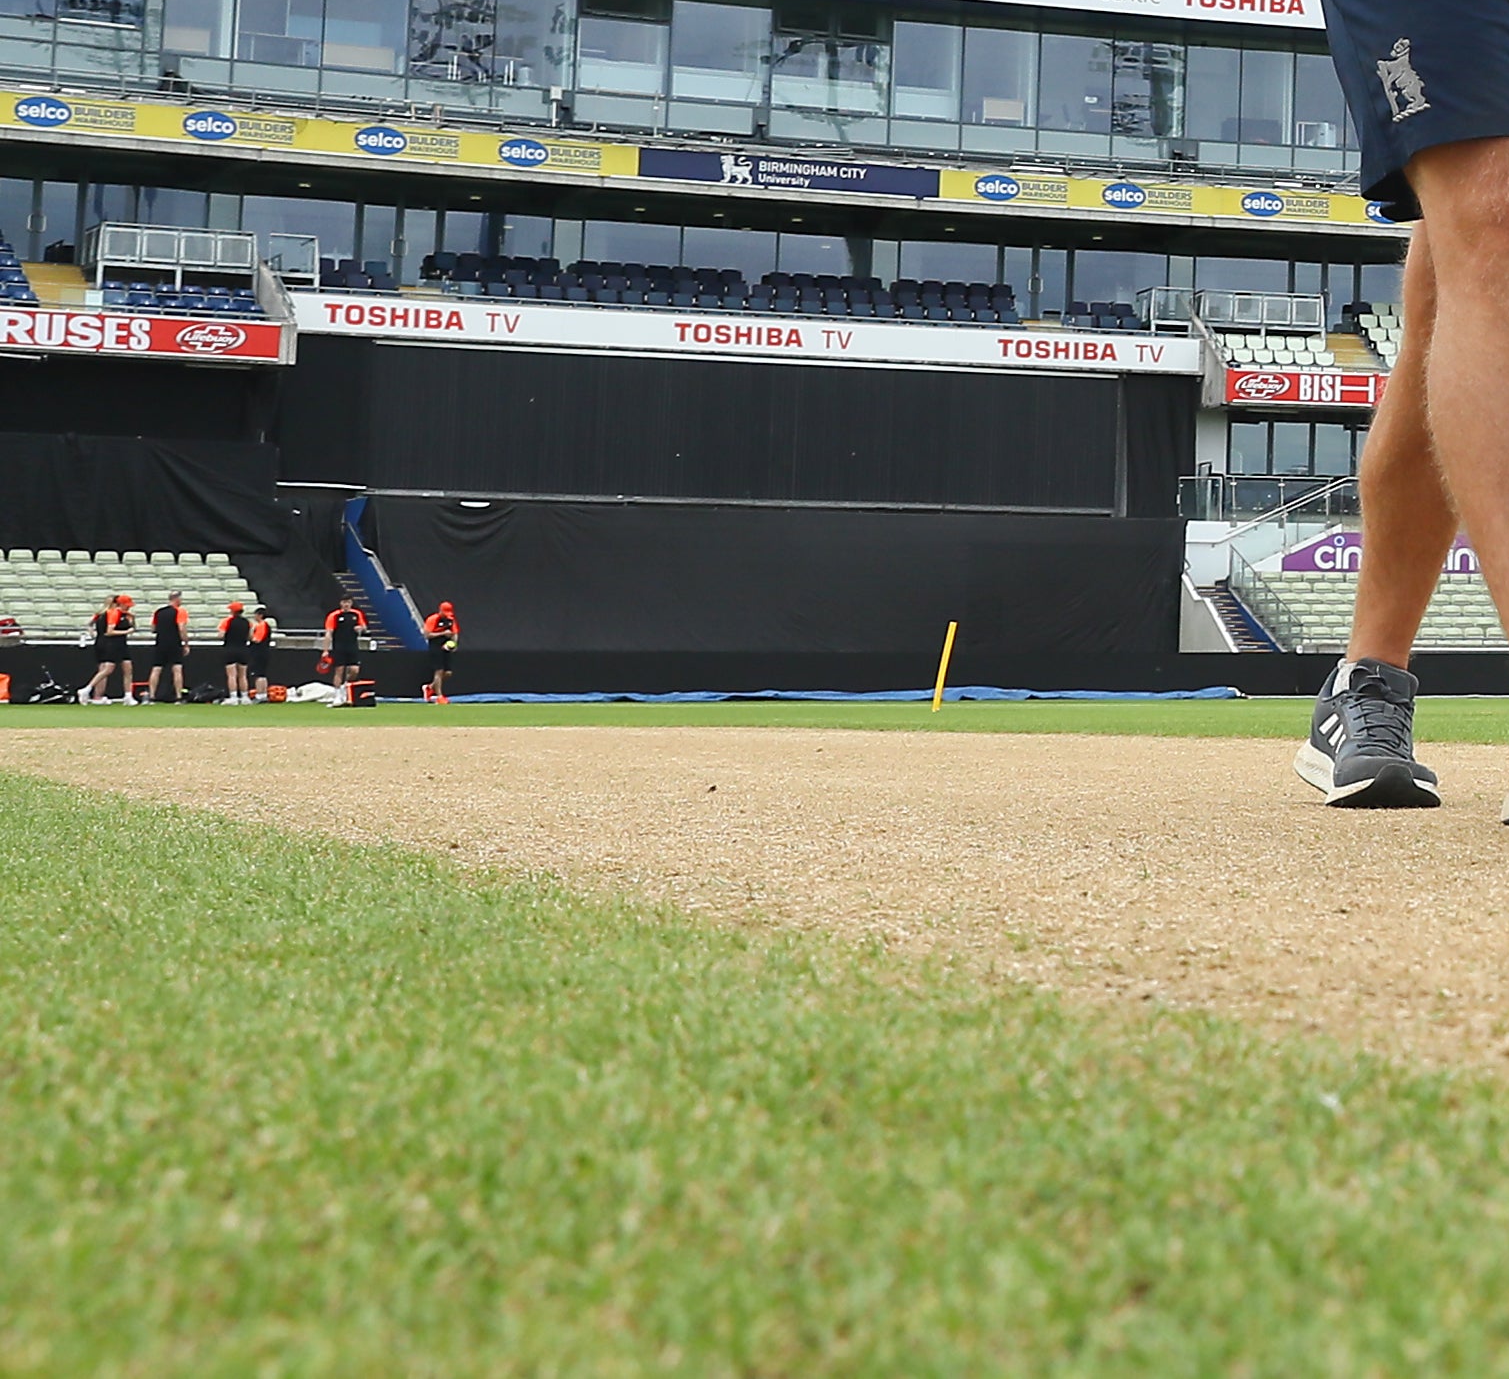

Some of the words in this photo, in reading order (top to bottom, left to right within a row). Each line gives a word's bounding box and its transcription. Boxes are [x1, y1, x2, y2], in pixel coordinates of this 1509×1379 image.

[17, 103, 70, 121] selco
[185, 118, 235, 135] selco
[239, 120, 295, 135] BUILDERS
[356, 132, 405, 149] selco
[501, 144, 546, 161] selco
[551, 147, 602, 161] BUILDERS
[758, 160, 838, 179] BIRMINGHAM
[839, 167, 867, 180] CITY
[758, 173, 811, 189] University
[977, 180, 1019, 196] selco
[1022, 182, 1068, 194] BUILDERS
[1105, 188, 1146, 204] selco
[1148, 190, 1193, 202] BUILDERS
[1243, 196, 1283, 212] selco
[1286, 199, 1330, 210] BUILDERS
[324, 303, 465, 331] TOSHIBA
[486, 312, 521, 334] TV
[184, 331, 236, 346] Lifebuoy
[674, 323, 803, 347] TOSHIBA
[821, 329, 853, 349] TV
[997, 338, 1118, 362] TOSHIBA
[1135, 344, 1164, 363] TV
[1241, 380, 1283, 392] Lifebuoy
[1299, 374, 1375, 403] BISH
[1314, 535, 1363, 570] cin
